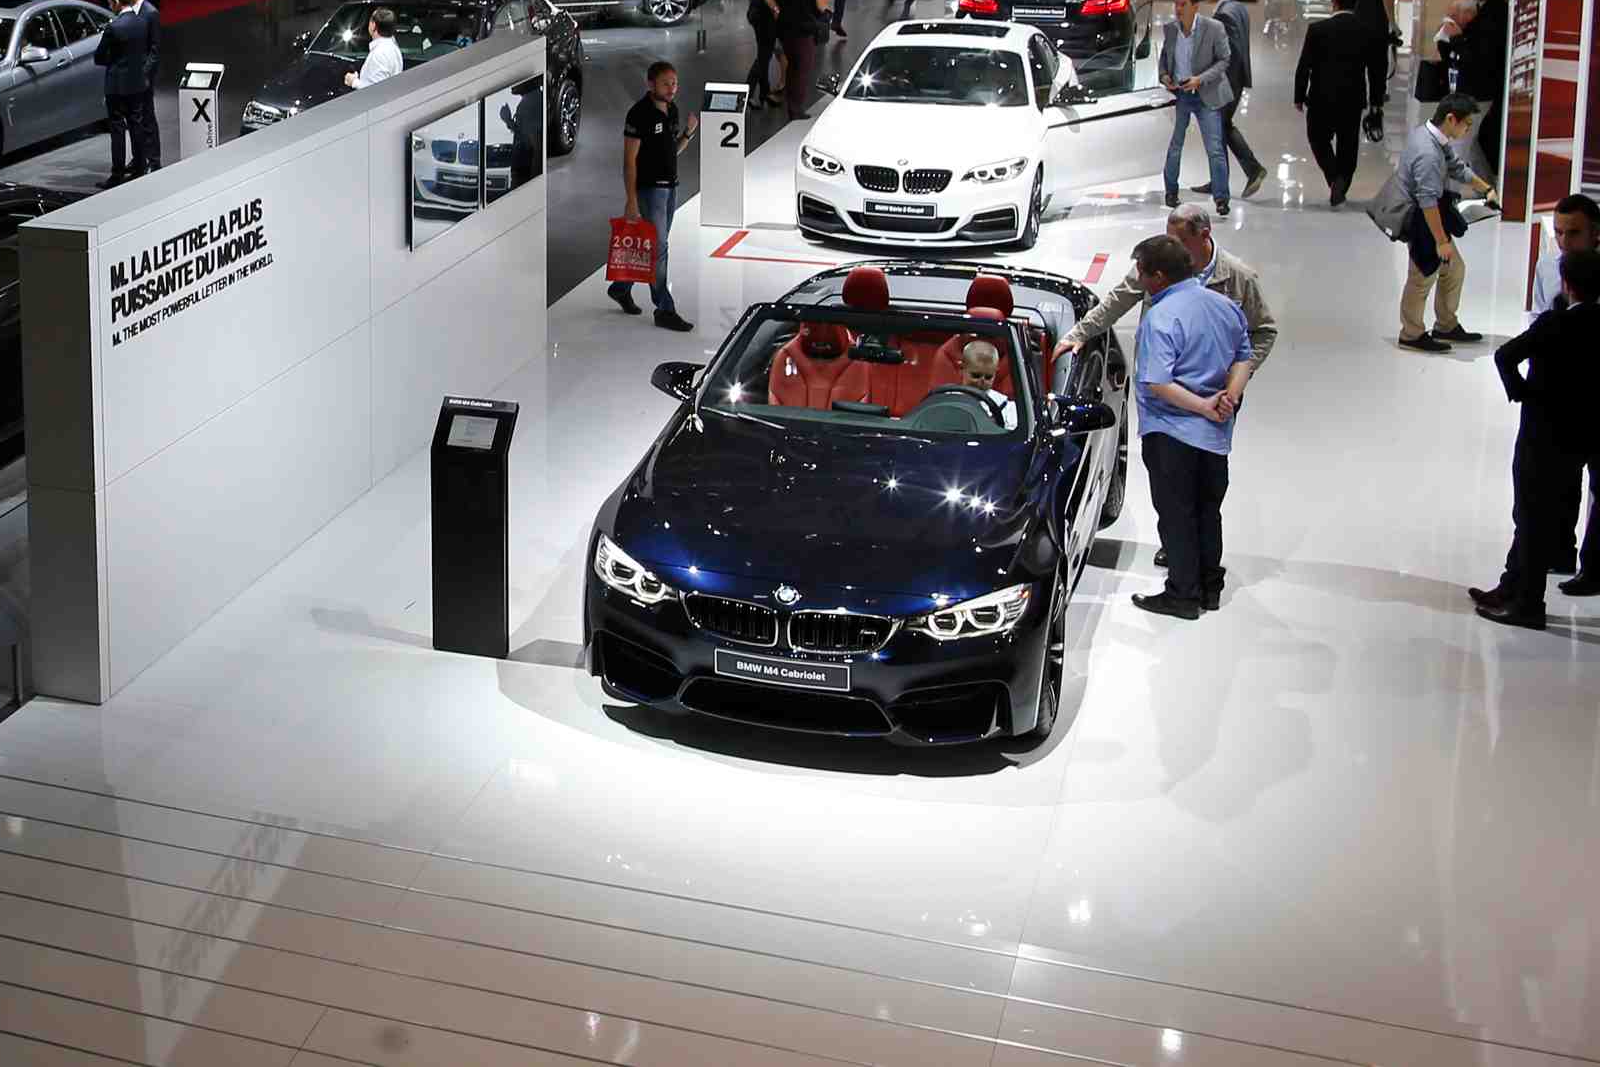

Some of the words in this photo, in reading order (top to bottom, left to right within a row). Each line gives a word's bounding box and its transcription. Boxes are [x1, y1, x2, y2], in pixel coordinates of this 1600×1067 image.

[192, 97, 211, 123] X
[720, 121, 739, 148] 2
[110, 261, 129, 291] M.
[131, 250, 151, 282] LA
[153, 223, 208, 271] LETTRE
[209, 215, 228, 244] LA
[229, 198, 263, 234] PLUS
[613, 236, 652, 251] 2014
[111, 260, 194, 324] PUISSANTE
[196, 249, 215, 280] DU
[217, 225, 268, 269] MONDE.
[123, 322, 139, 341] THE
[139, 310, 161, 334] MOST
[162, 290, 201, 321] POWERFUL
[201, 276, 228, 299] LETTER
[228, 272, 236, 287] IN
[236, 265, 249, 282] THE
[736, 661, 762, 674] BMW
[763, 665, 779, 677] M4
[780, 668, 826, 682] Cabriolet
